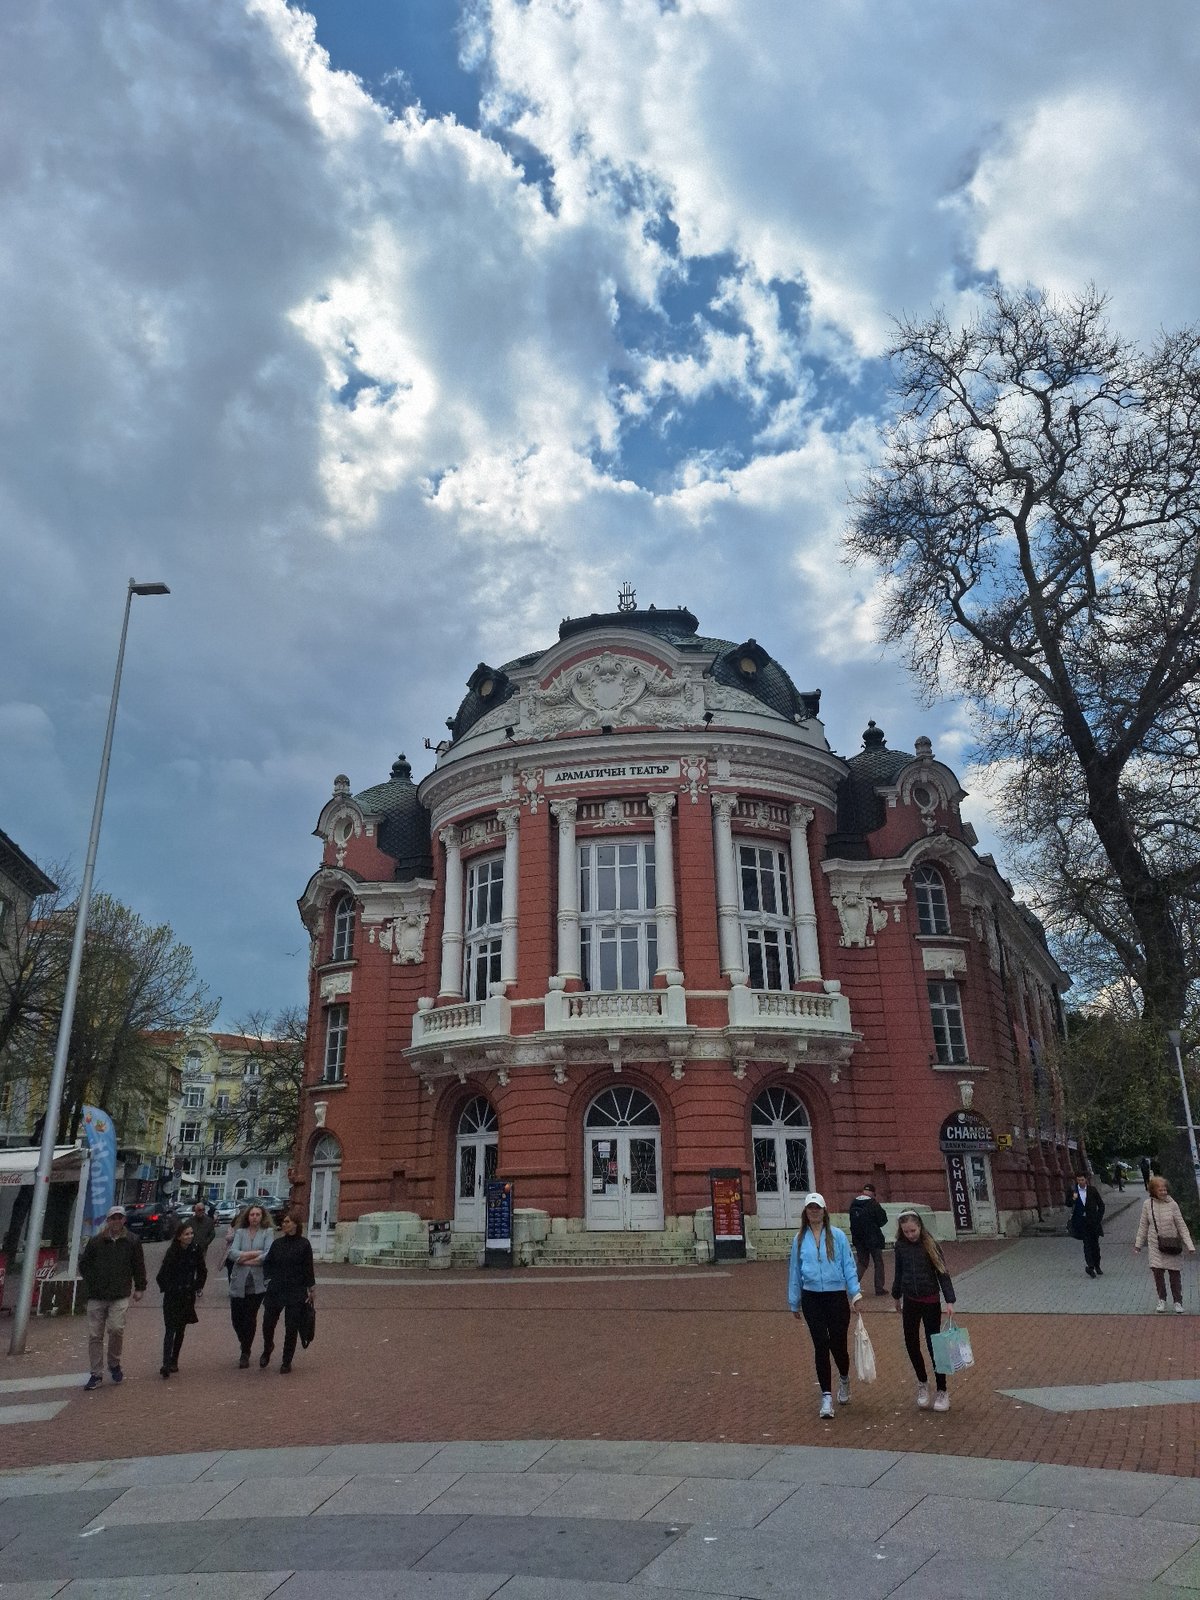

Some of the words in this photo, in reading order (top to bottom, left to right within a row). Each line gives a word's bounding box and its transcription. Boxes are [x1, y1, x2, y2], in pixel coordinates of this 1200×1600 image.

[555, 767, 626, 782] ДРАМАТИЧЕН
[629, 765, 670, 775] ТЕАТЪР
[946, 1126, 993, 1140] CHANGE
[952, 1158, 968, 1227] CHANGE
